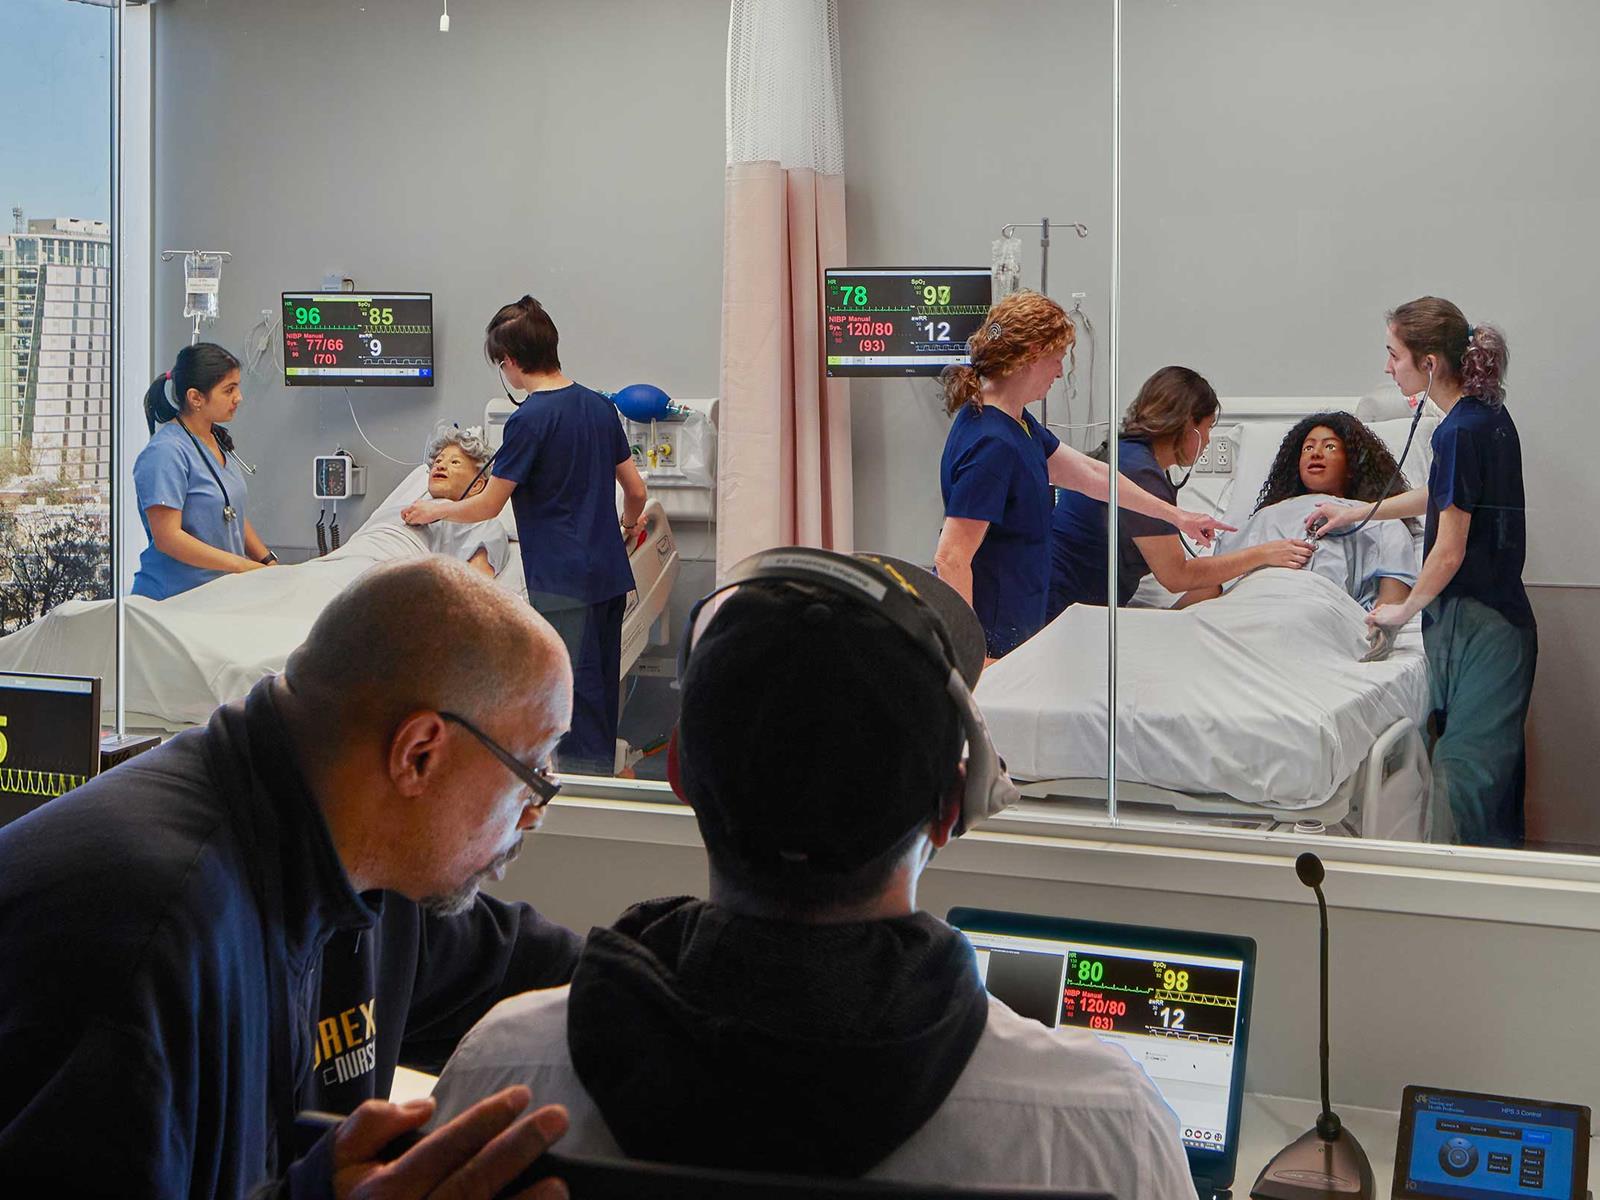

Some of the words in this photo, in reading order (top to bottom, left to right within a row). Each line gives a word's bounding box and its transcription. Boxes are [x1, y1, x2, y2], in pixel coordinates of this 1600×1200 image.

[840, 286, 868, 306] 78
[295, 307, 321, 325] 96
[369, 307, 394, 325] 85
[846, 322, 894, 336] 120/80
[924, 321, 951, 342] 12
[306, 338, 344, 351] 77/66
[369, 338, 382, 357] 9
[859, 339, 885, 352] (93)
[313, 353, 337, 365] (70)
[1078, 960, 1104, 983] 80
[1163, 969, 1190, 992] 98
[1063, 988, 1081, 998] NIBP
[1082, 991, 1104, 999] Manual
[1080, 997, 1127, 1017] 120/80
[1089, 1015, 1114, 1031] (93)
[1160, 1006, 1186, 1031] 12
[1521, 1110, 1542, 1118] Control
